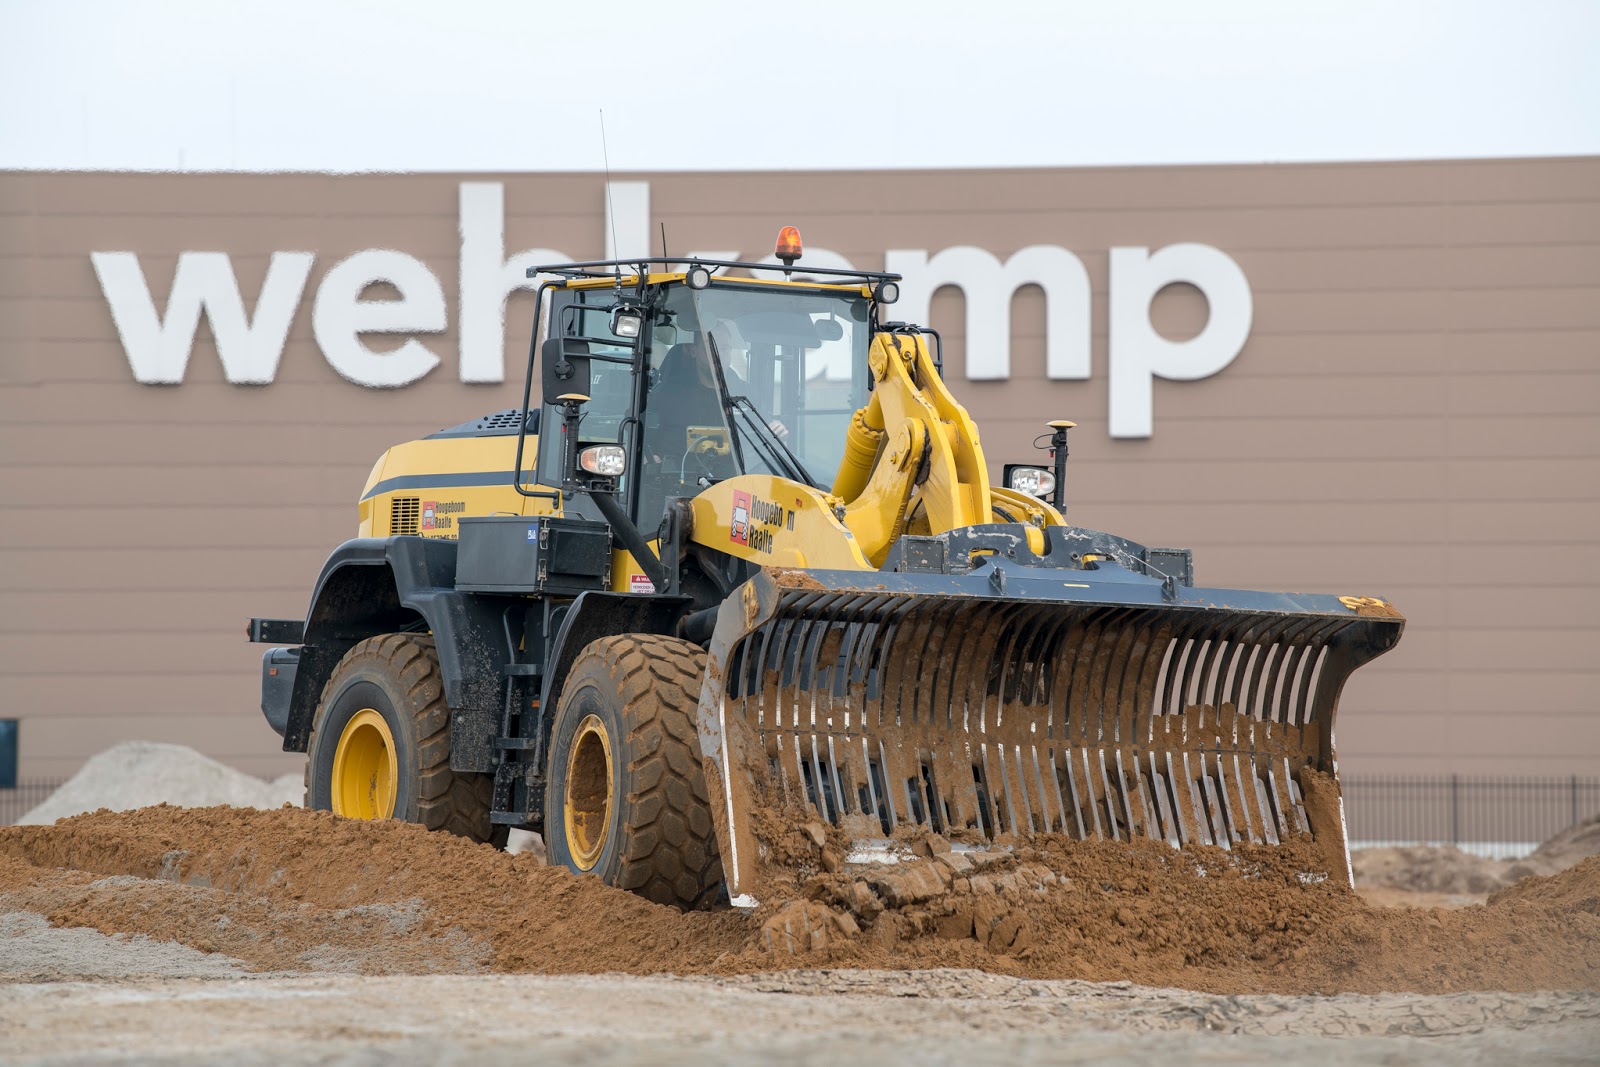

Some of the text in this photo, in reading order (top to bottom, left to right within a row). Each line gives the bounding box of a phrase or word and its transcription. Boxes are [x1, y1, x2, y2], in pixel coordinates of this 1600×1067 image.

[90, 181, 1253, 438] wehmp
[435, 501, 465, 514] Hoogeboom
[435, 516, 451, 528] Raalte
[751, 495, 795, 531] Hoogebom
[749, 524, 773, 555] Raalte
